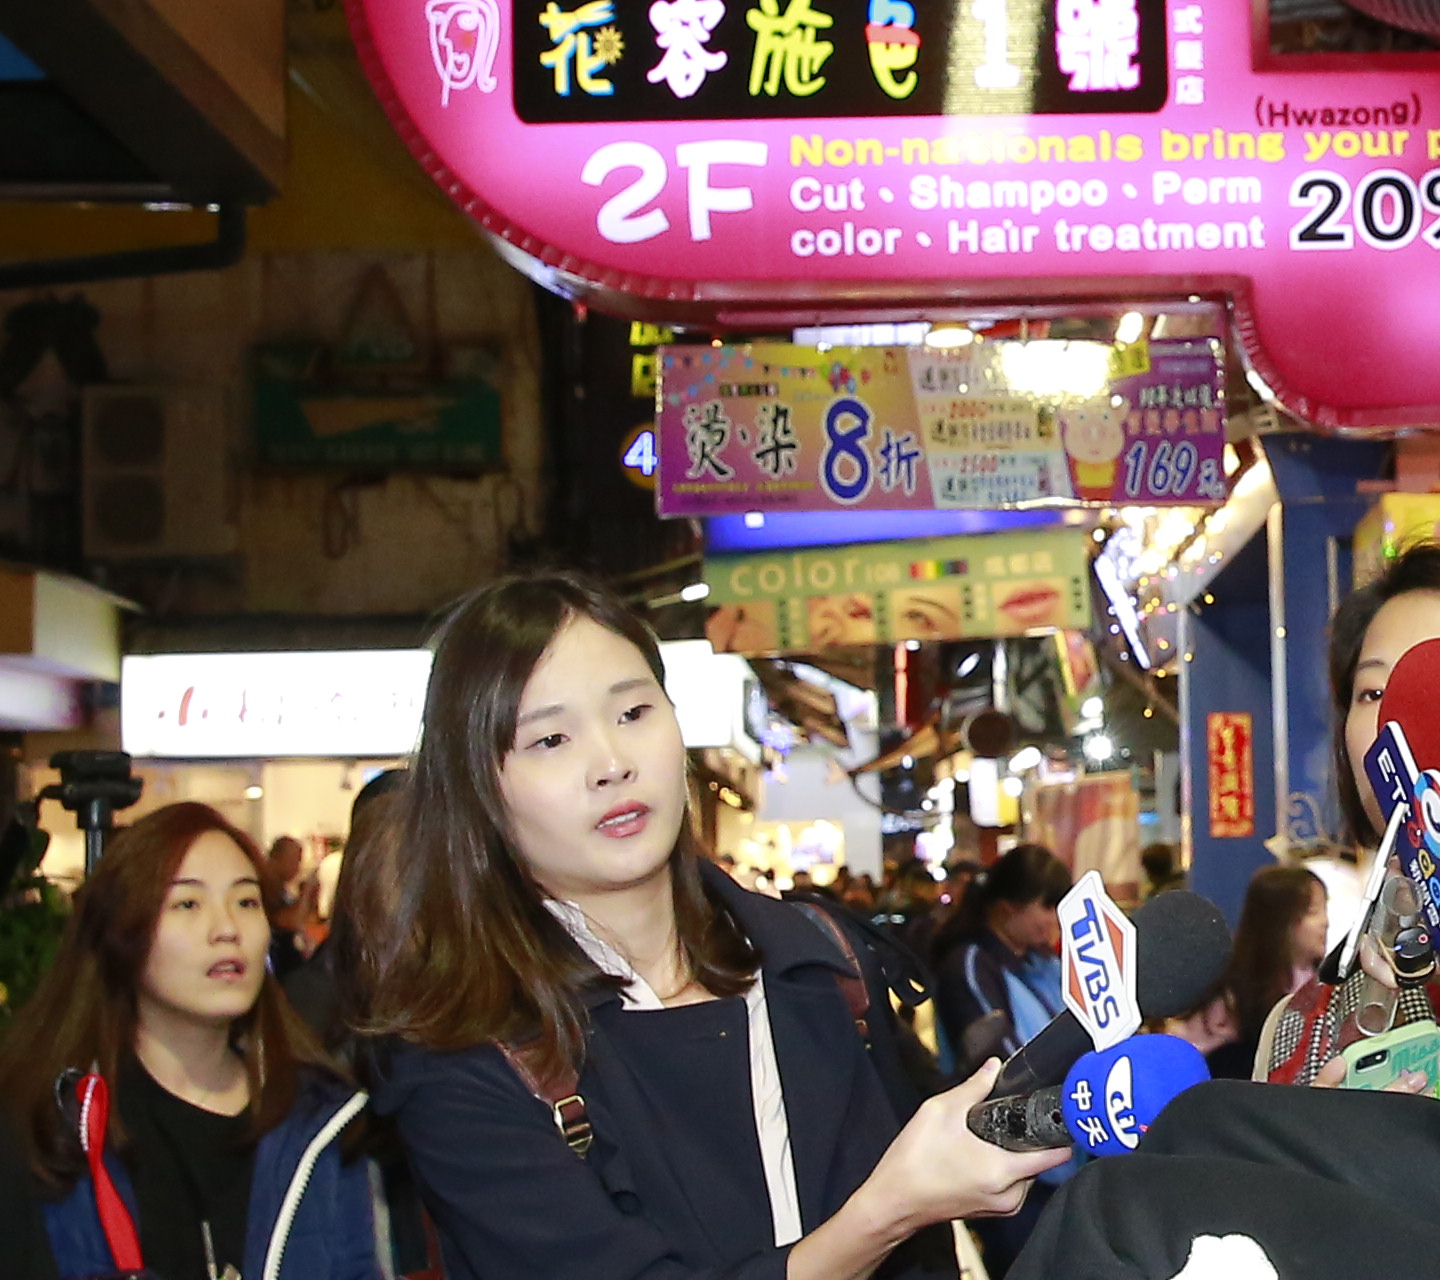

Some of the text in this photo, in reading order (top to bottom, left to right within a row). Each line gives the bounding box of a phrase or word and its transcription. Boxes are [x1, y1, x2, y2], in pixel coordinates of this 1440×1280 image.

[1254, 93, 1422, 128] (Hwazong)
[789, 128, 1144, 167] Non-nationals
[1160, 127, 1286, 163] bring
[1303, 126, 1410, 163] your
[579, 138, 769, 245] 2F
[789, 170, 1263, 214] Cut Shampoo Perm
[790, 215, 1266, 258] color Hair treatment
[730, 556, 859, 595] color
[1070, 897, 1121, 1030] TVBS
[1070, 1079, 1109, 1148] 中天
